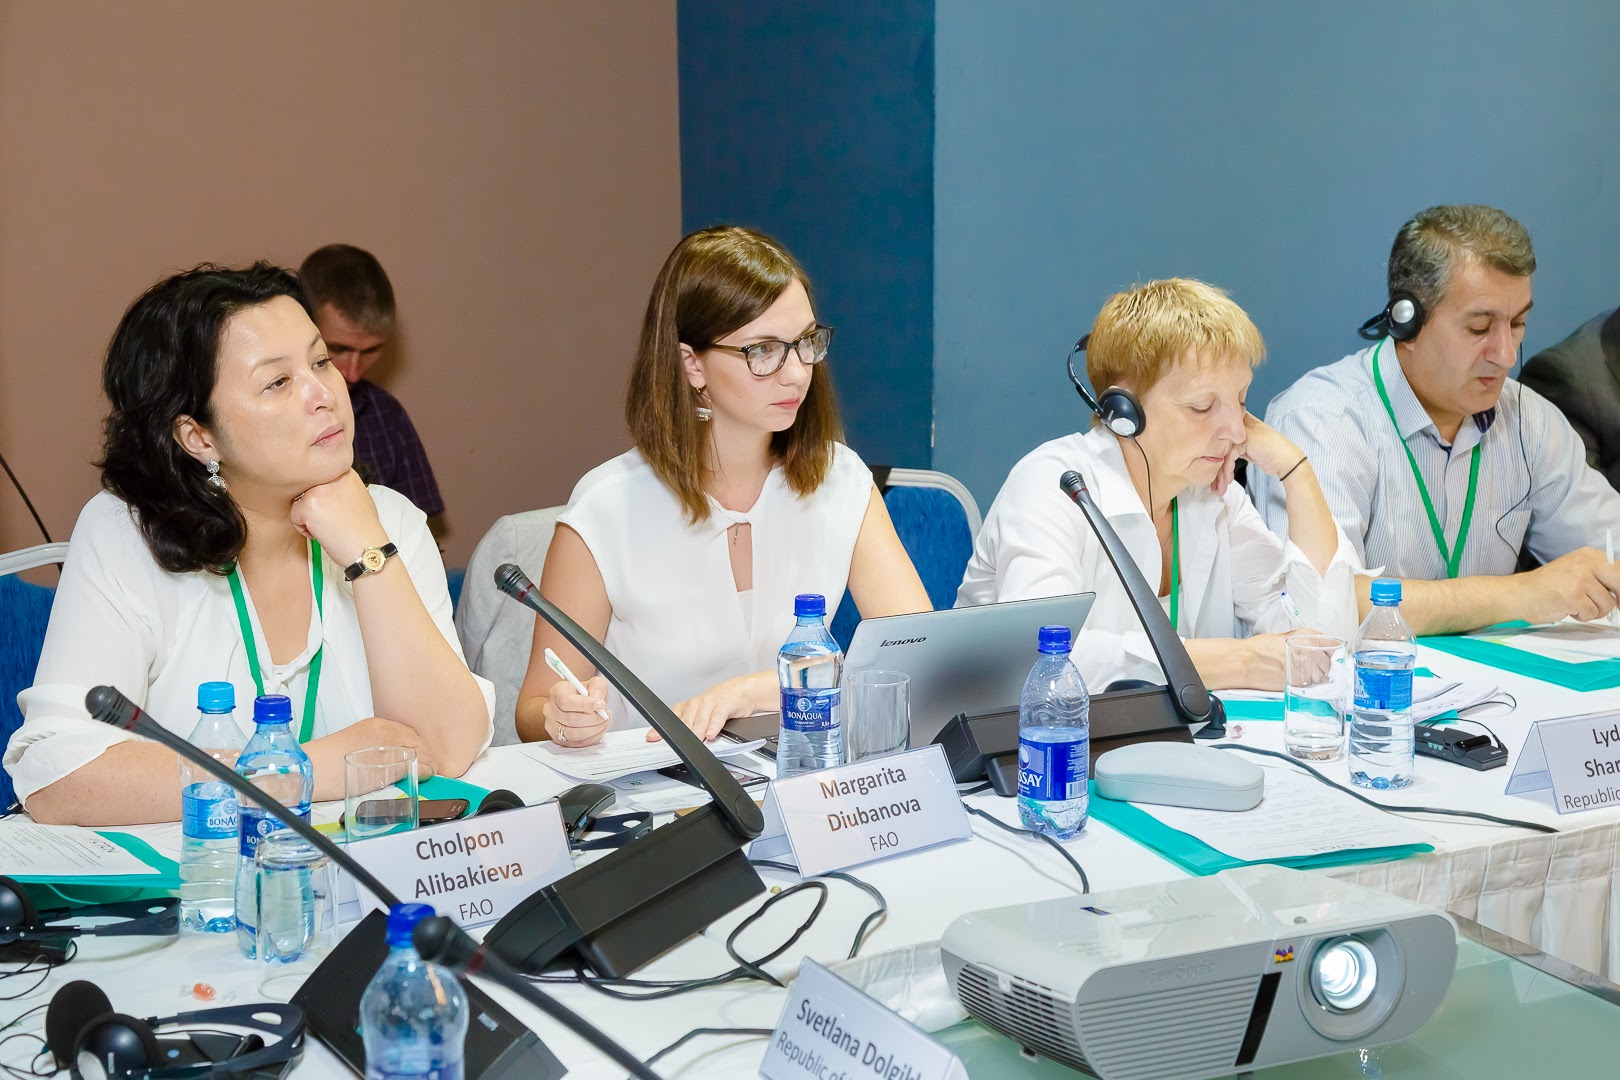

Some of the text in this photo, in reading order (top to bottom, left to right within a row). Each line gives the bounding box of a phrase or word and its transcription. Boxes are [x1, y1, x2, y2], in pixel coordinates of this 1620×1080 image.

[880, 636, 927, 648] lenovo
[787, 710, 823, 721] BONAQUA
[1592, 724, 1620, 747] Lyd
[819, 766, 907, 800] Margarita
[1563, 786, 1620, 810] Republic
[826, 795, 922, 832] Diubanova
[415, 829, 505, 861] Cholpon
[869, 831, 899, 852] FAO
[414, 861, 524, 899] Alibakieva
[459, 898, 494, 921] FAO
[796, 998, 861, 1058] Svetlana
[775, 1031, 829, 1080] Republic
